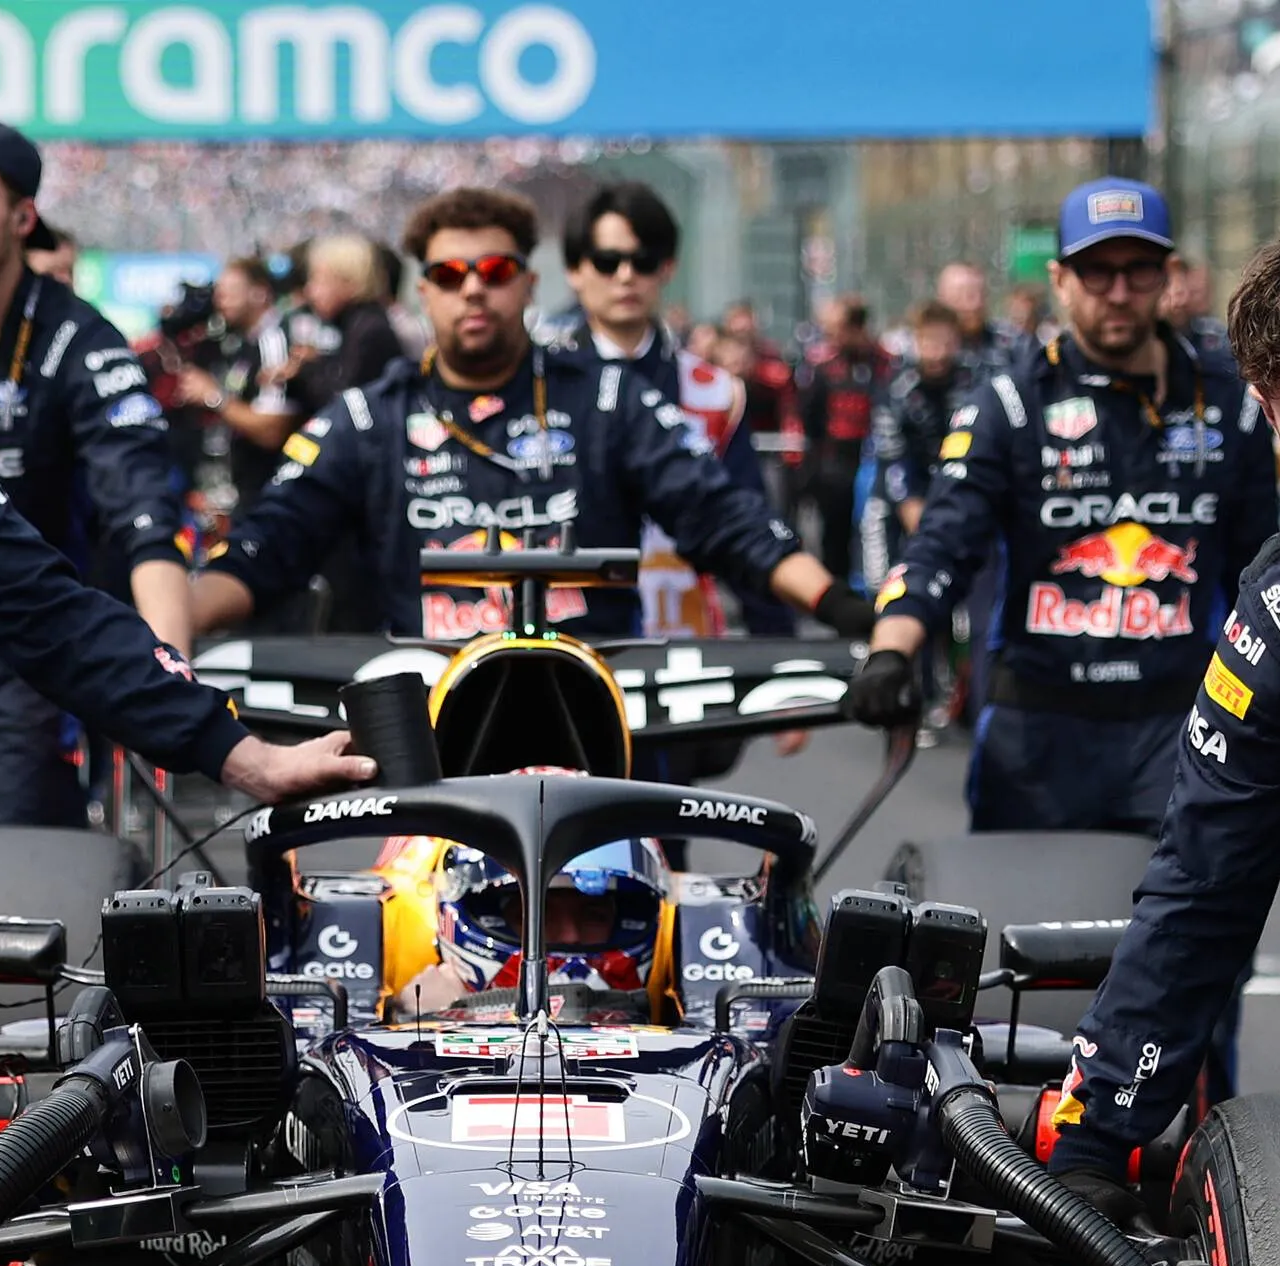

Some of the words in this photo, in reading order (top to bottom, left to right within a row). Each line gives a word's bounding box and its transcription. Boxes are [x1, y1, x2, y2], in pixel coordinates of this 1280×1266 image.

[407, 489, 579, 530] ORACLE
[1040, 491, 1220, 528] ORACLE
[1026, 581, 1122, 639] Red
[304, 795, 399, 823] DAMAC
[678, 798, 768, 826] DAMAC
[303, 959, 375, 981] Gate
[682, 961, 754, 982] Gate
[112, 1055, 135, 1091] YETI
[825, 1118, 892, 1145] YETI
[469, 1181, 582, 1196] VISA
[523, 1195, 606, 1205] INFINITE
[503, 1205, 607, 1219] Gate
[520, 1224, 611, 1239] AT&T
[497, 1244, 580, 1257] AVA
